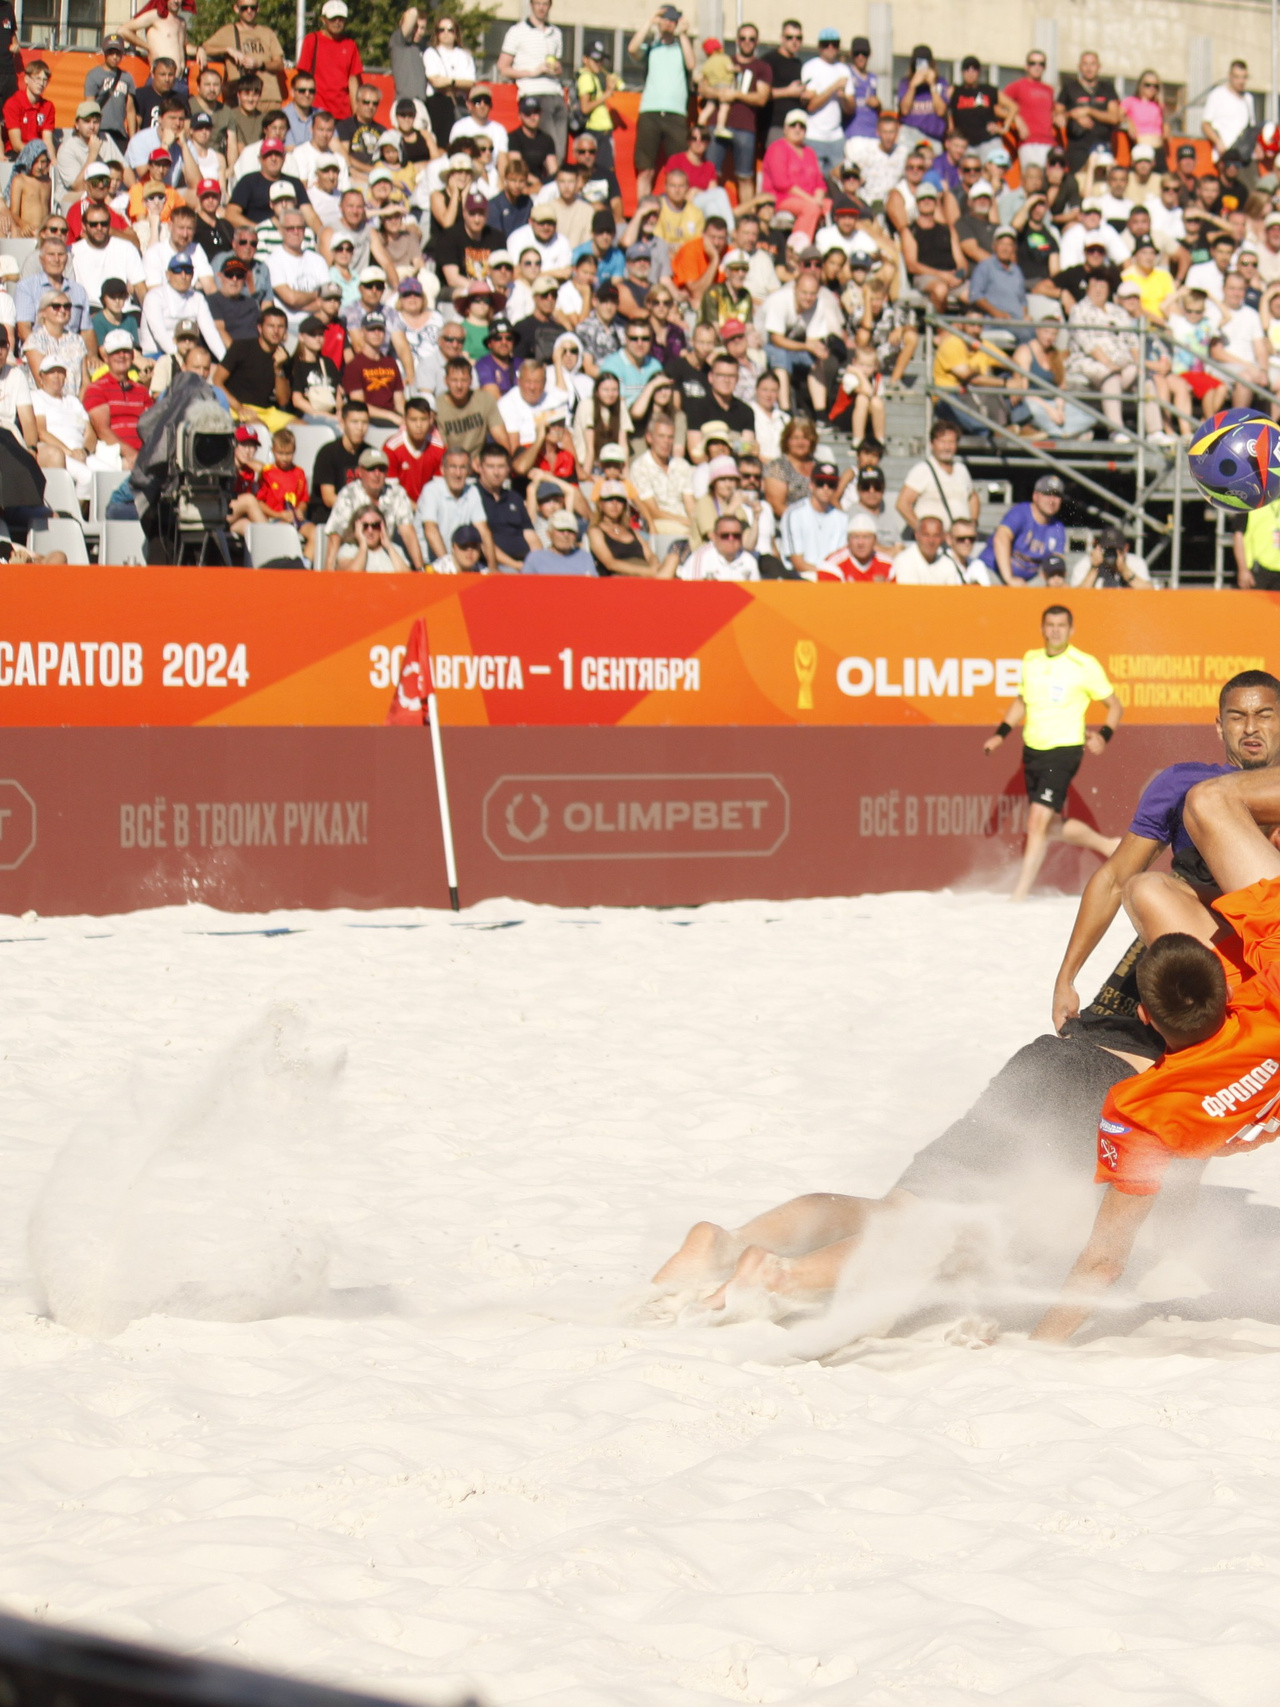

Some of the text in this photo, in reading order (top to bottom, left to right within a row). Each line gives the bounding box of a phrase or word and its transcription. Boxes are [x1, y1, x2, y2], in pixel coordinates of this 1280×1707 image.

[0, 641, 250, 688] САРАТОВ 2024
[558, 648, 574, 691] 1
[581, 656, 700, 692] СЕНТЯБРЯ
[836, 656, 1021, 697] OLIMPB
[1109, 654, 1200, 680] ЧЕМПИОНАТ
[1133, 684, 1220, 708] ПЛЯЖНОМ
[120, 797, 369, 849] ВСЁ В ТВОИХ РУКАХ!
[563, 800, 769, 832] OLIMPBET
[859, 789, 899, 837] ВСЁ
[905, 797, 918, 837] В
[925, 796, 993, 836] ТВОИХ
[1201, 1058, 1280, 1118] ФРОЛОВ
